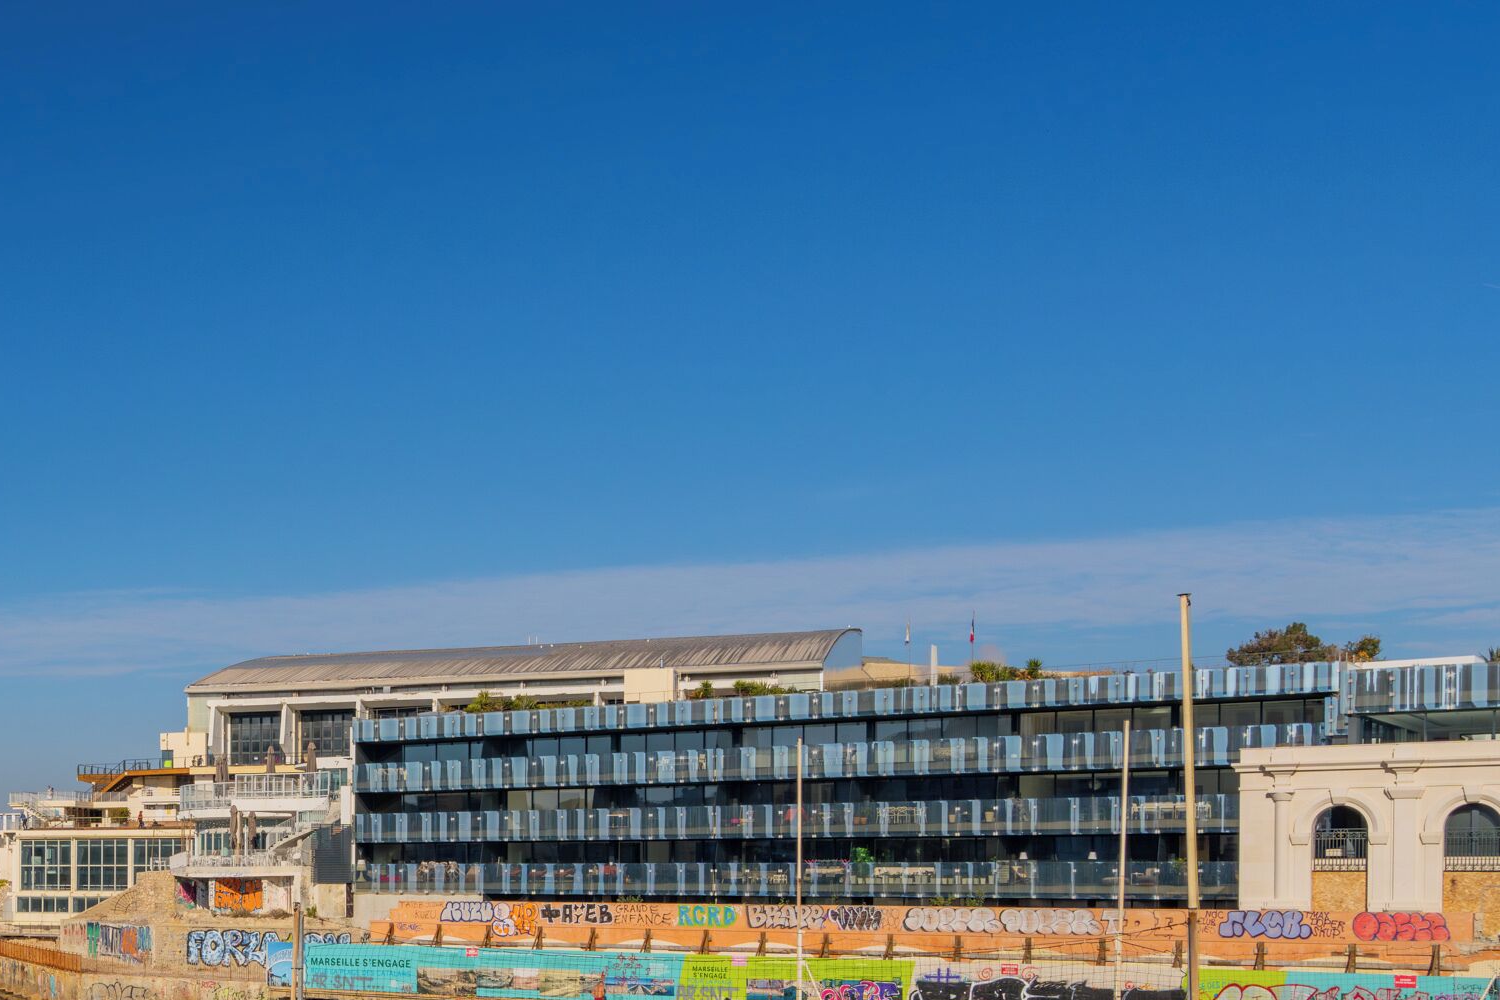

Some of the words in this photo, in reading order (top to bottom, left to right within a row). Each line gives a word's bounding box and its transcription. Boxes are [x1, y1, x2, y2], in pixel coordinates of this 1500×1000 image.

[614, 912, 673, 926] ENFANCE
[310, 957, 360, 967] MARSEILLE
[363, 958, 411, 968] S'ENGAGE
[692, 966, 728, 974] MARSEILLE
[693, 972, 727, 980] S'ENGAGE
